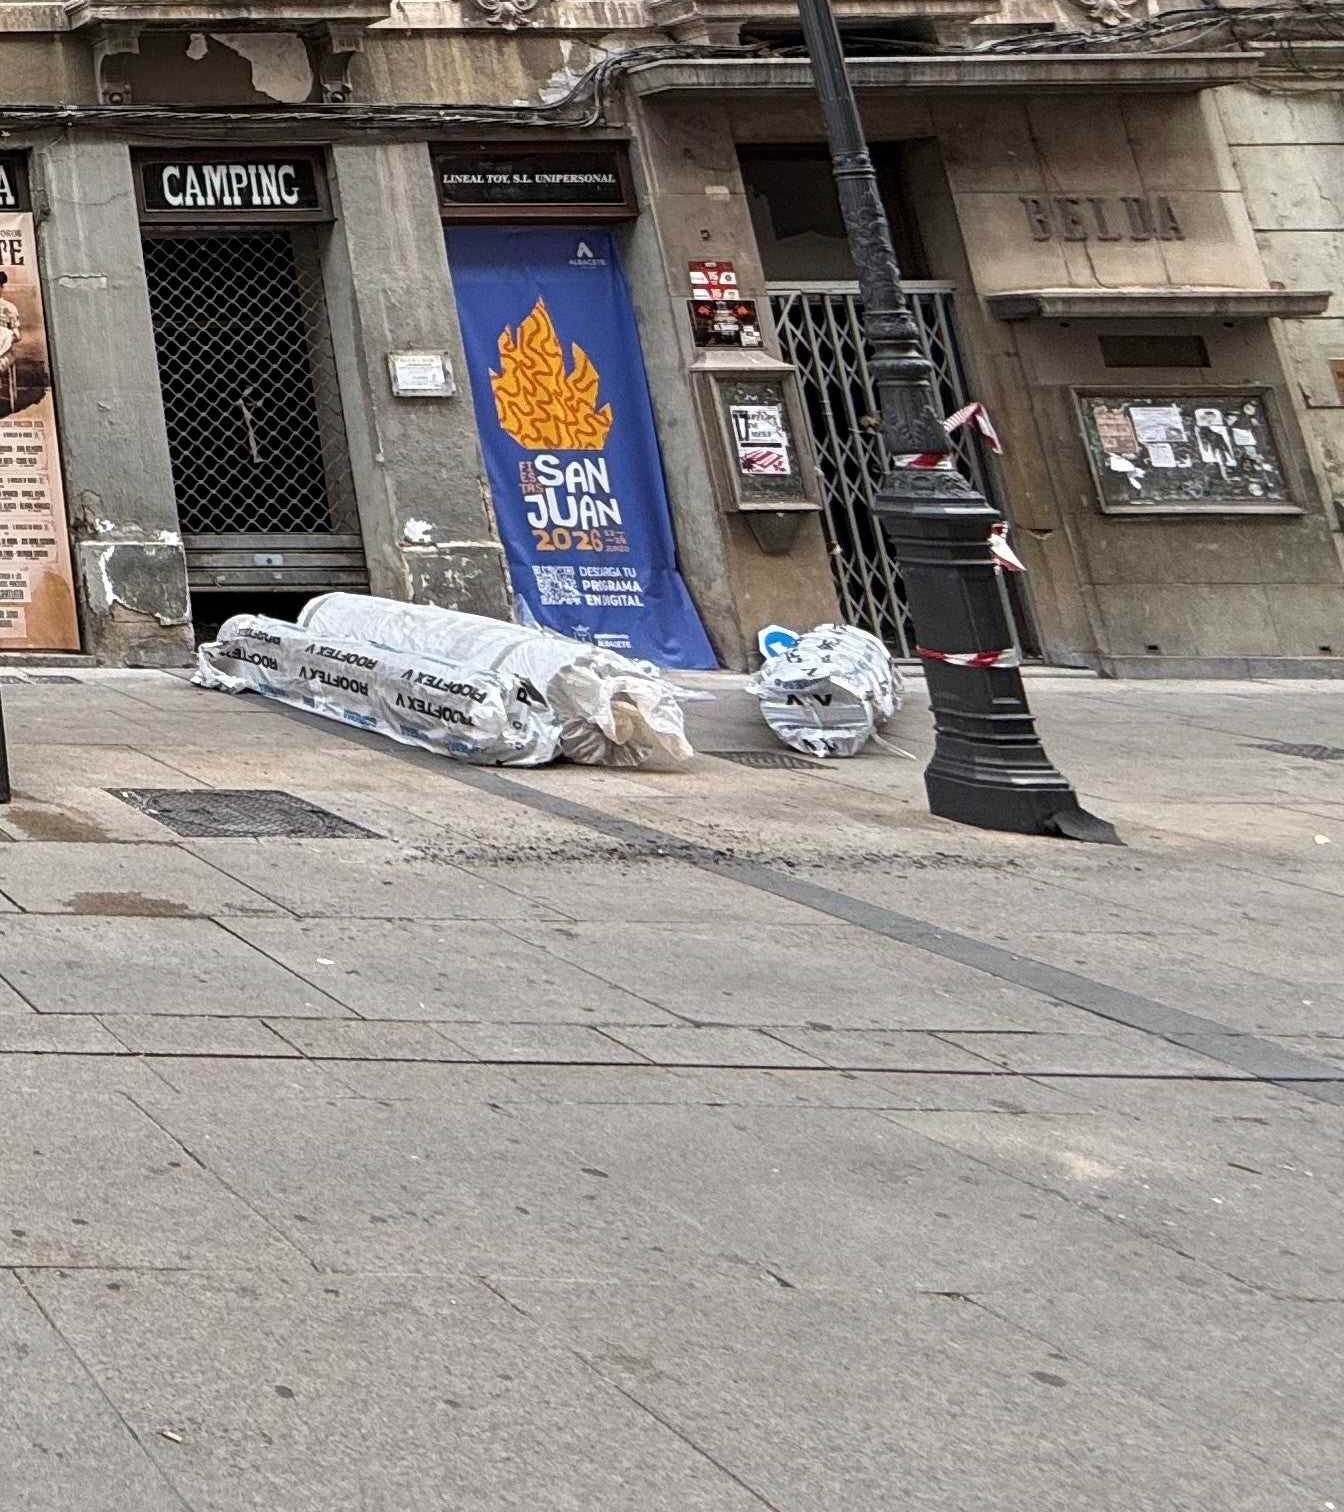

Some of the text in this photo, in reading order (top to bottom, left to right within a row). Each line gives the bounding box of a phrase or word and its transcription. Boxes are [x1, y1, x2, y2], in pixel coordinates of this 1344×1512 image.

[163, 164, 300, 206] CAMPING
[443, 175, 484, 183] LINEAL
[513, 175, 532, 183] S.L.
[535, 174, 616, 183] UNIPERSONAL
[1018, 195, 1187, 242] BELDA
[534, 455, 610, 494] SAN
[524, 488, 622, 530] JUAN
[531, 528, 603, 552] 2026
[622, 566, 636, 577] TU
[317, 645, 378, 670] ROOFTEX
[311, 668, 368, 696] ROOFTEX
[414, 672, 487, 704] ROOFTEX
